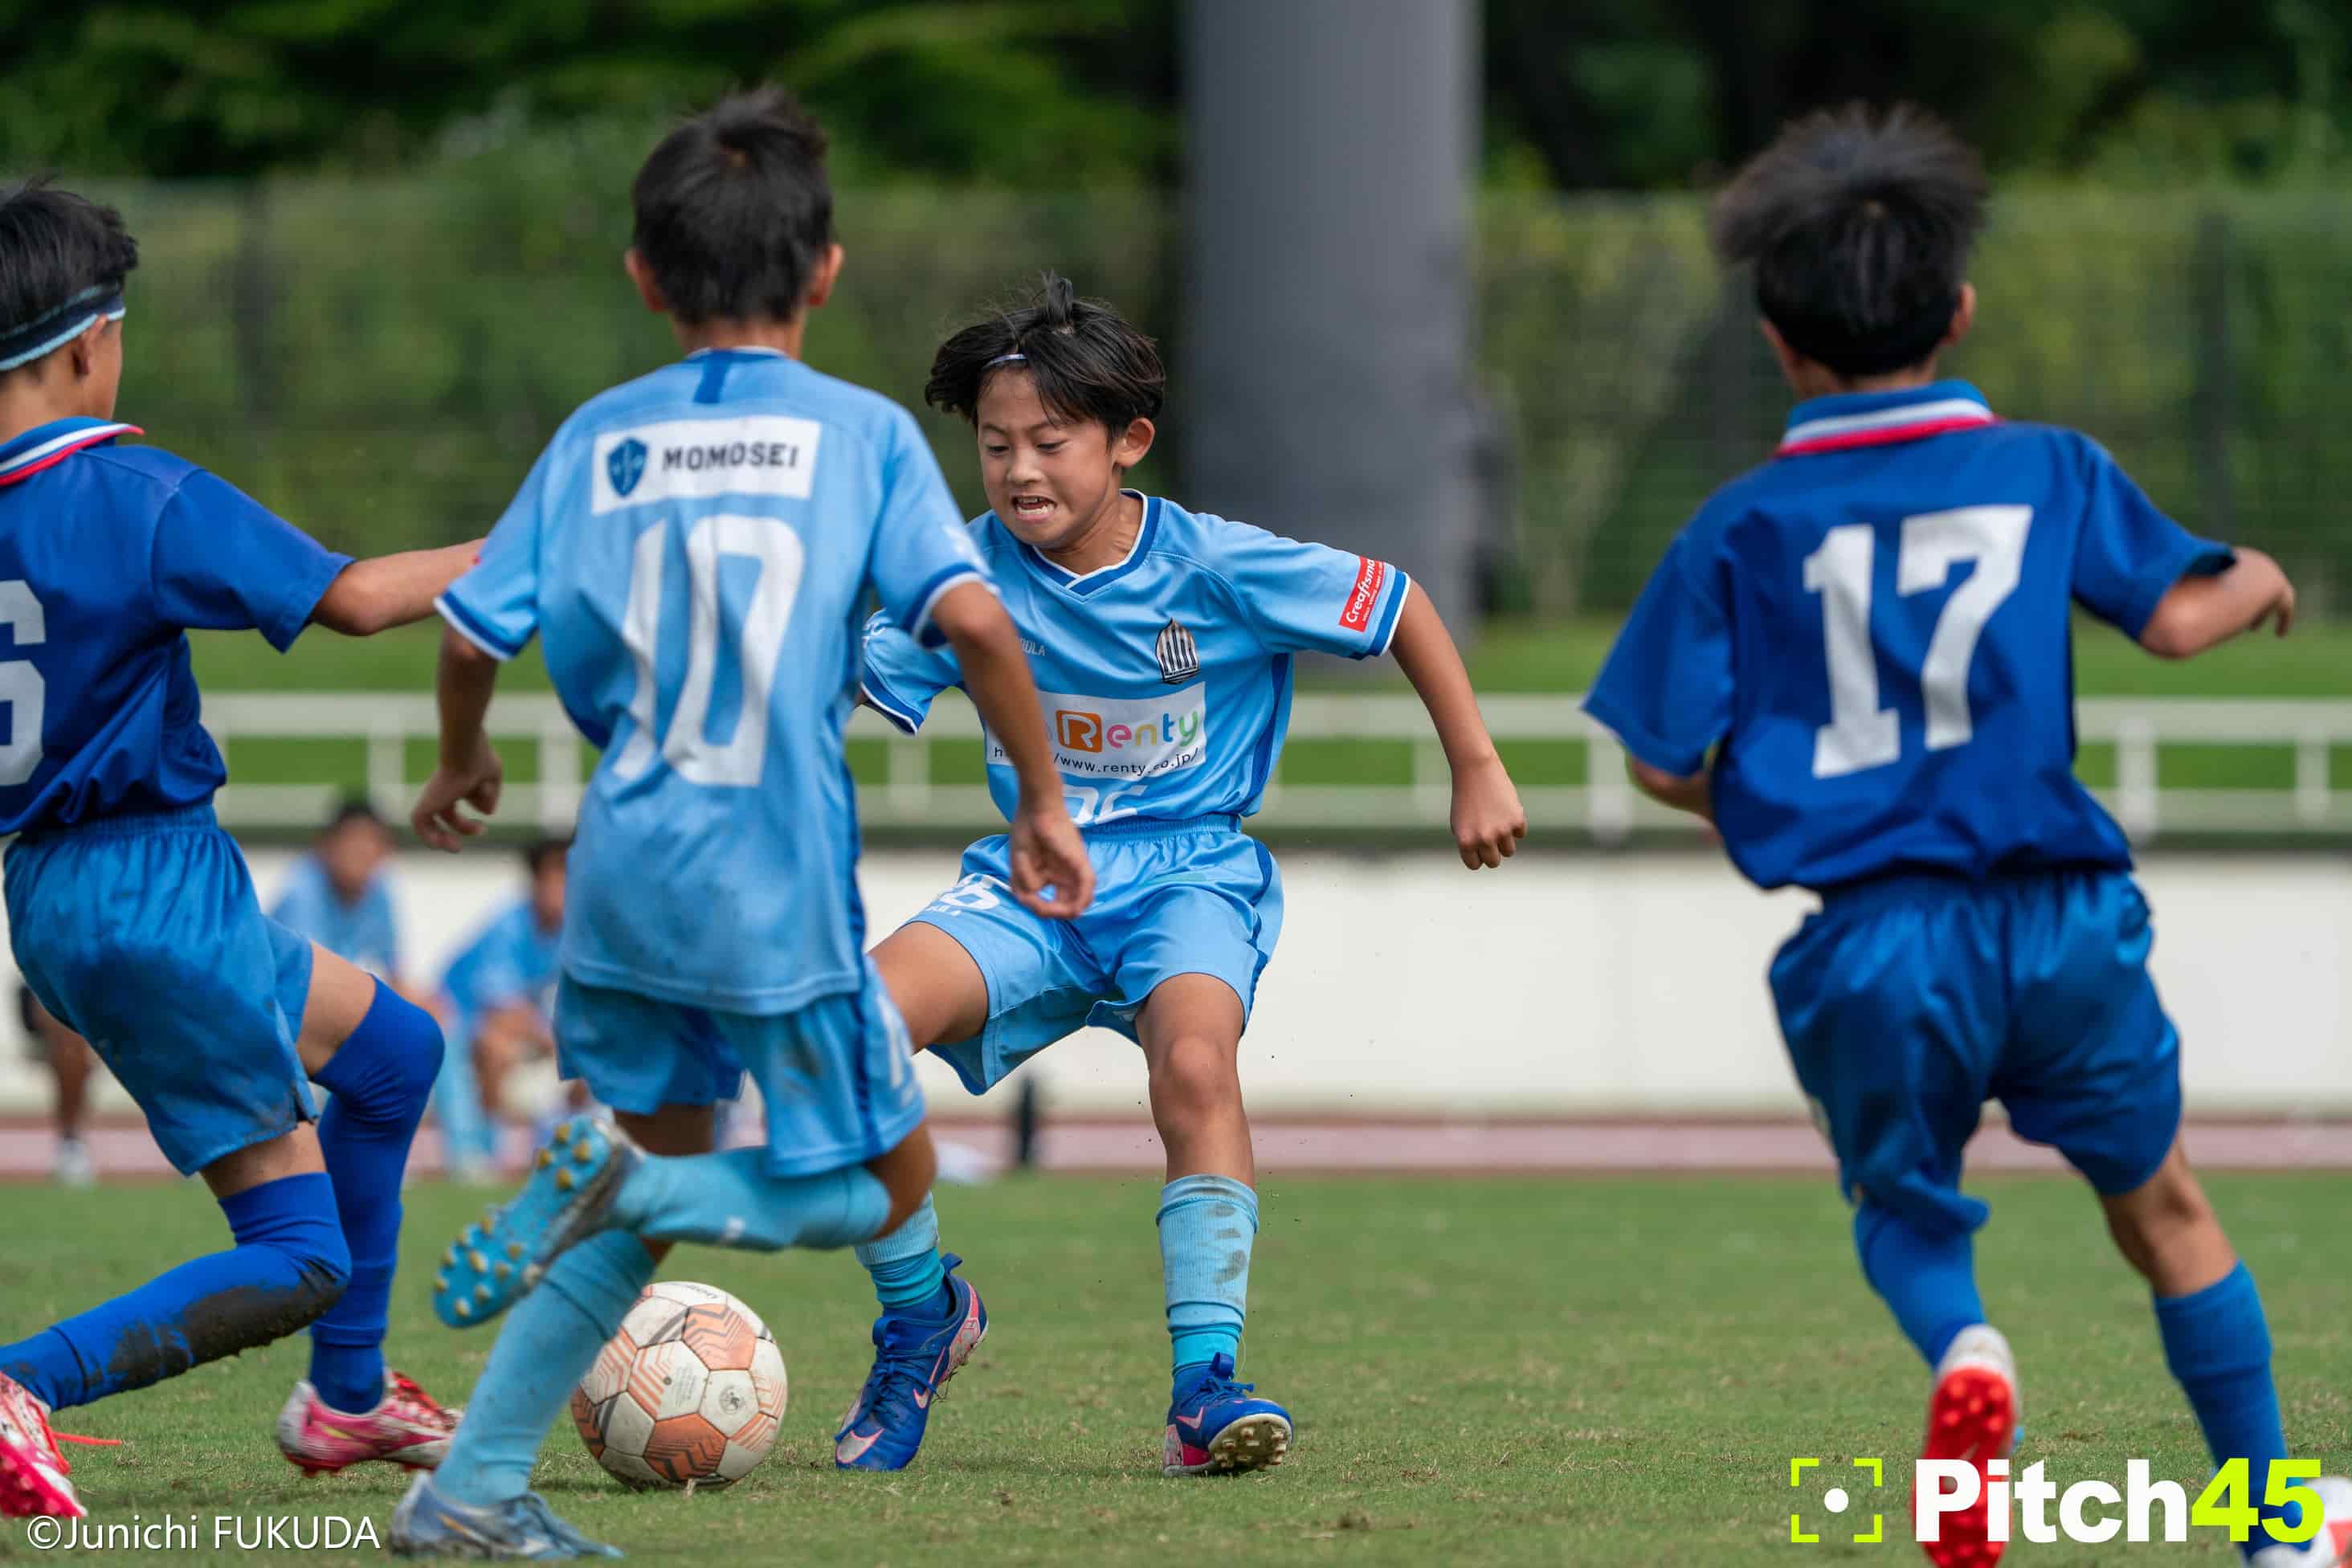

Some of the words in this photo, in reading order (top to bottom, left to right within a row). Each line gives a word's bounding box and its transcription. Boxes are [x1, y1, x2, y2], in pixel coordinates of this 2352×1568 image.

[663, 442, 798, 471] MOMOSEI
[613, 515, 803, 786] 10
[1803, 505, 2032, 778] 17
[1056, 710, 1198, 752] Renty
